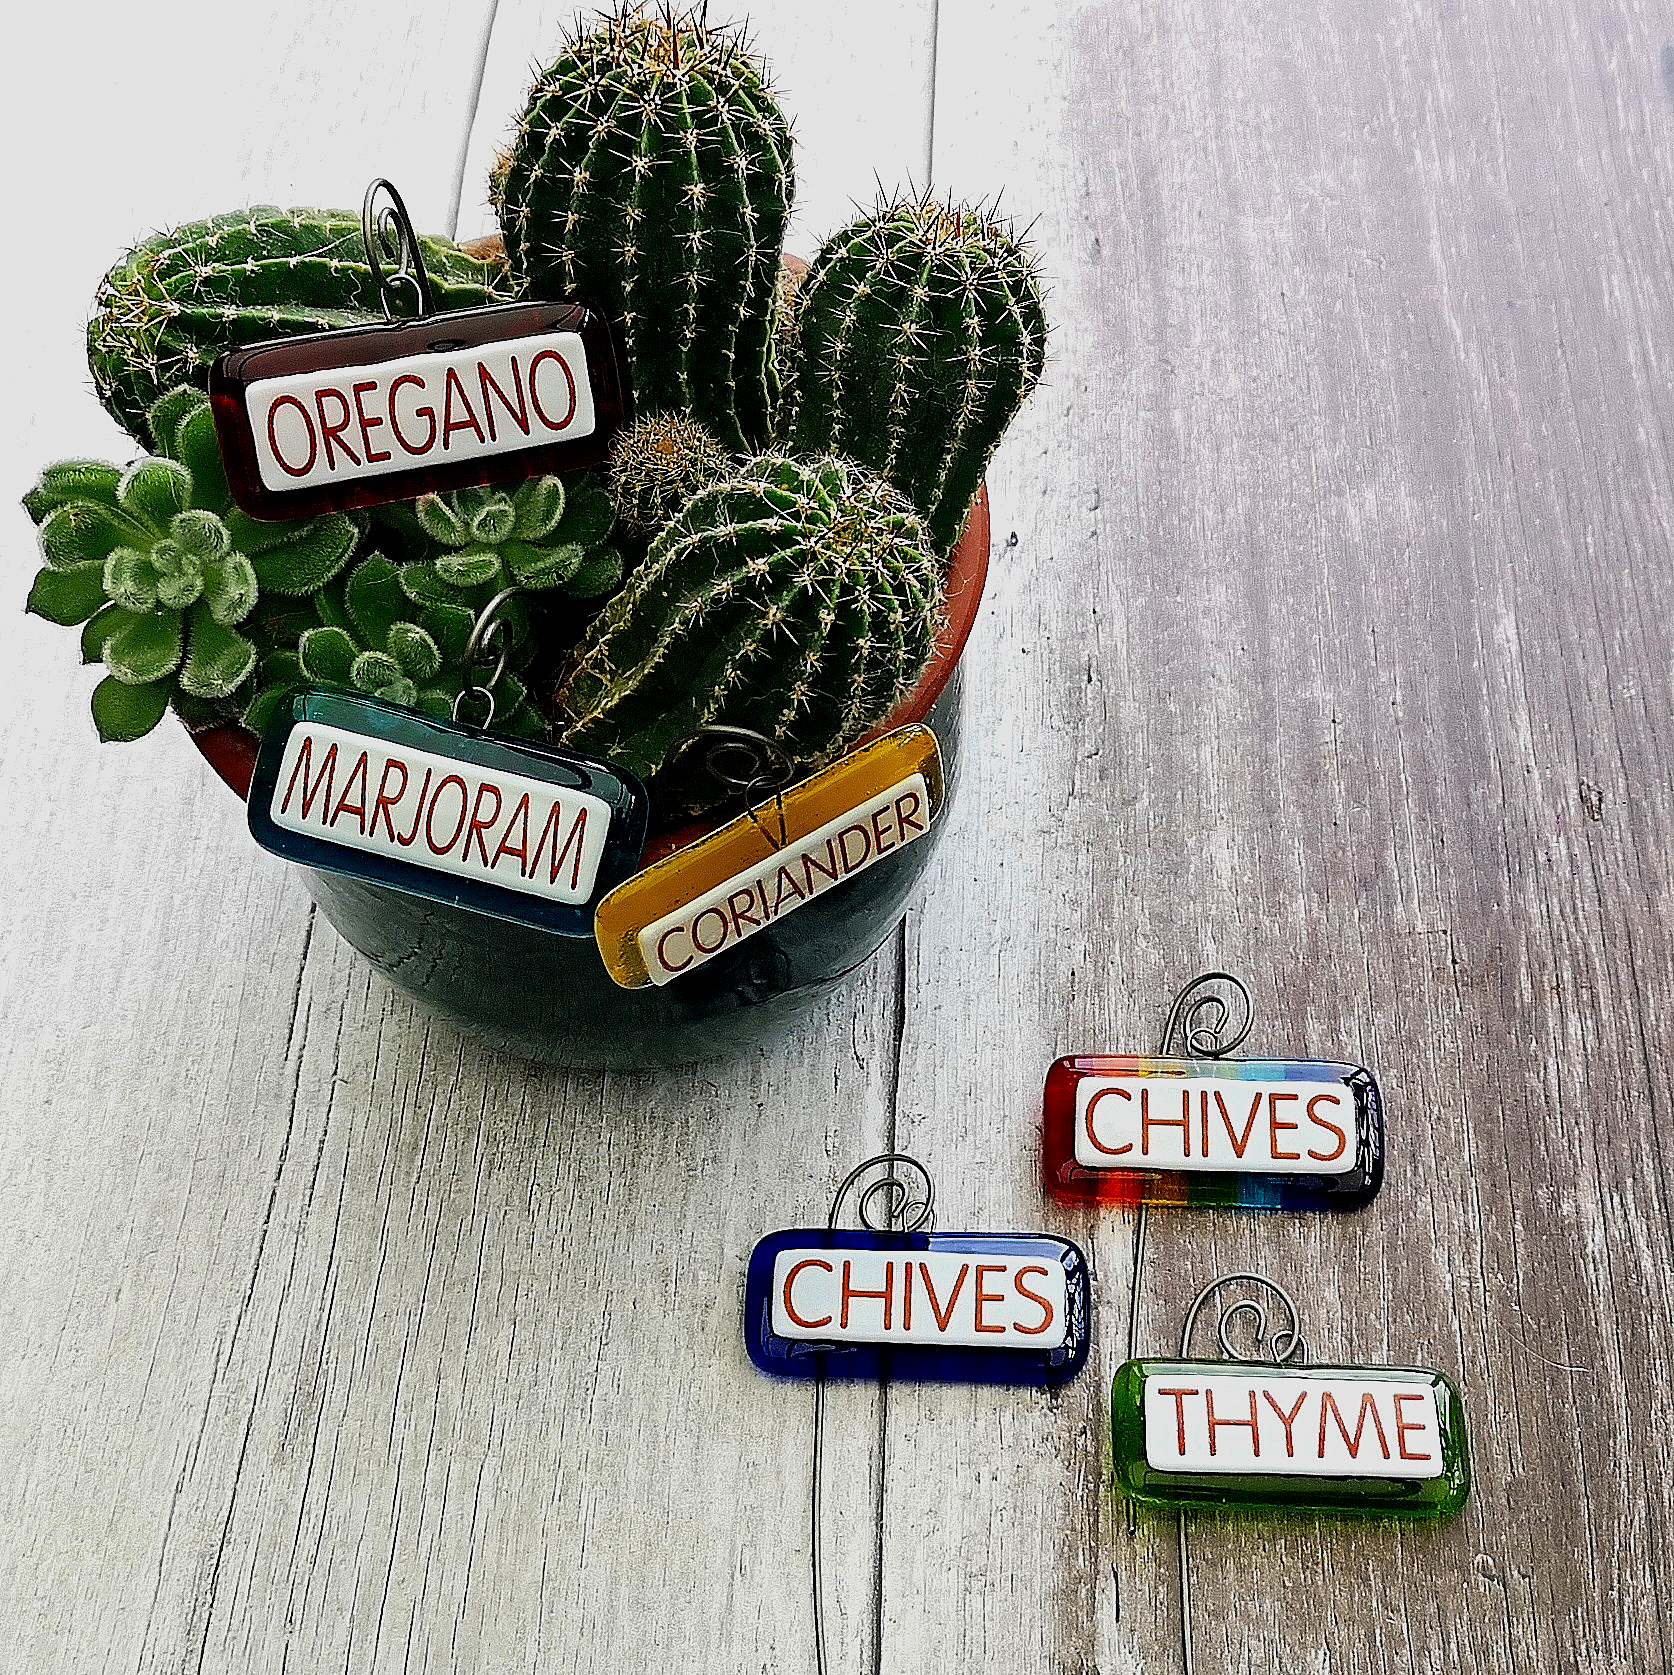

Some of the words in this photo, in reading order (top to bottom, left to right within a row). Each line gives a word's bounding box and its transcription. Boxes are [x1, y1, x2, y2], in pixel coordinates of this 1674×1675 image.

[267, 349, 577, 477] OREGANO
[281, 735, 588, 890] MARJORAM
[656, 790, 924, 974] CORIANDER
[1085, 1087, 1347, 1162] CHIVES
[783, 1259, 1055, 1335] CHIVES
[1158, 1388, 1432, 1461] THYME
